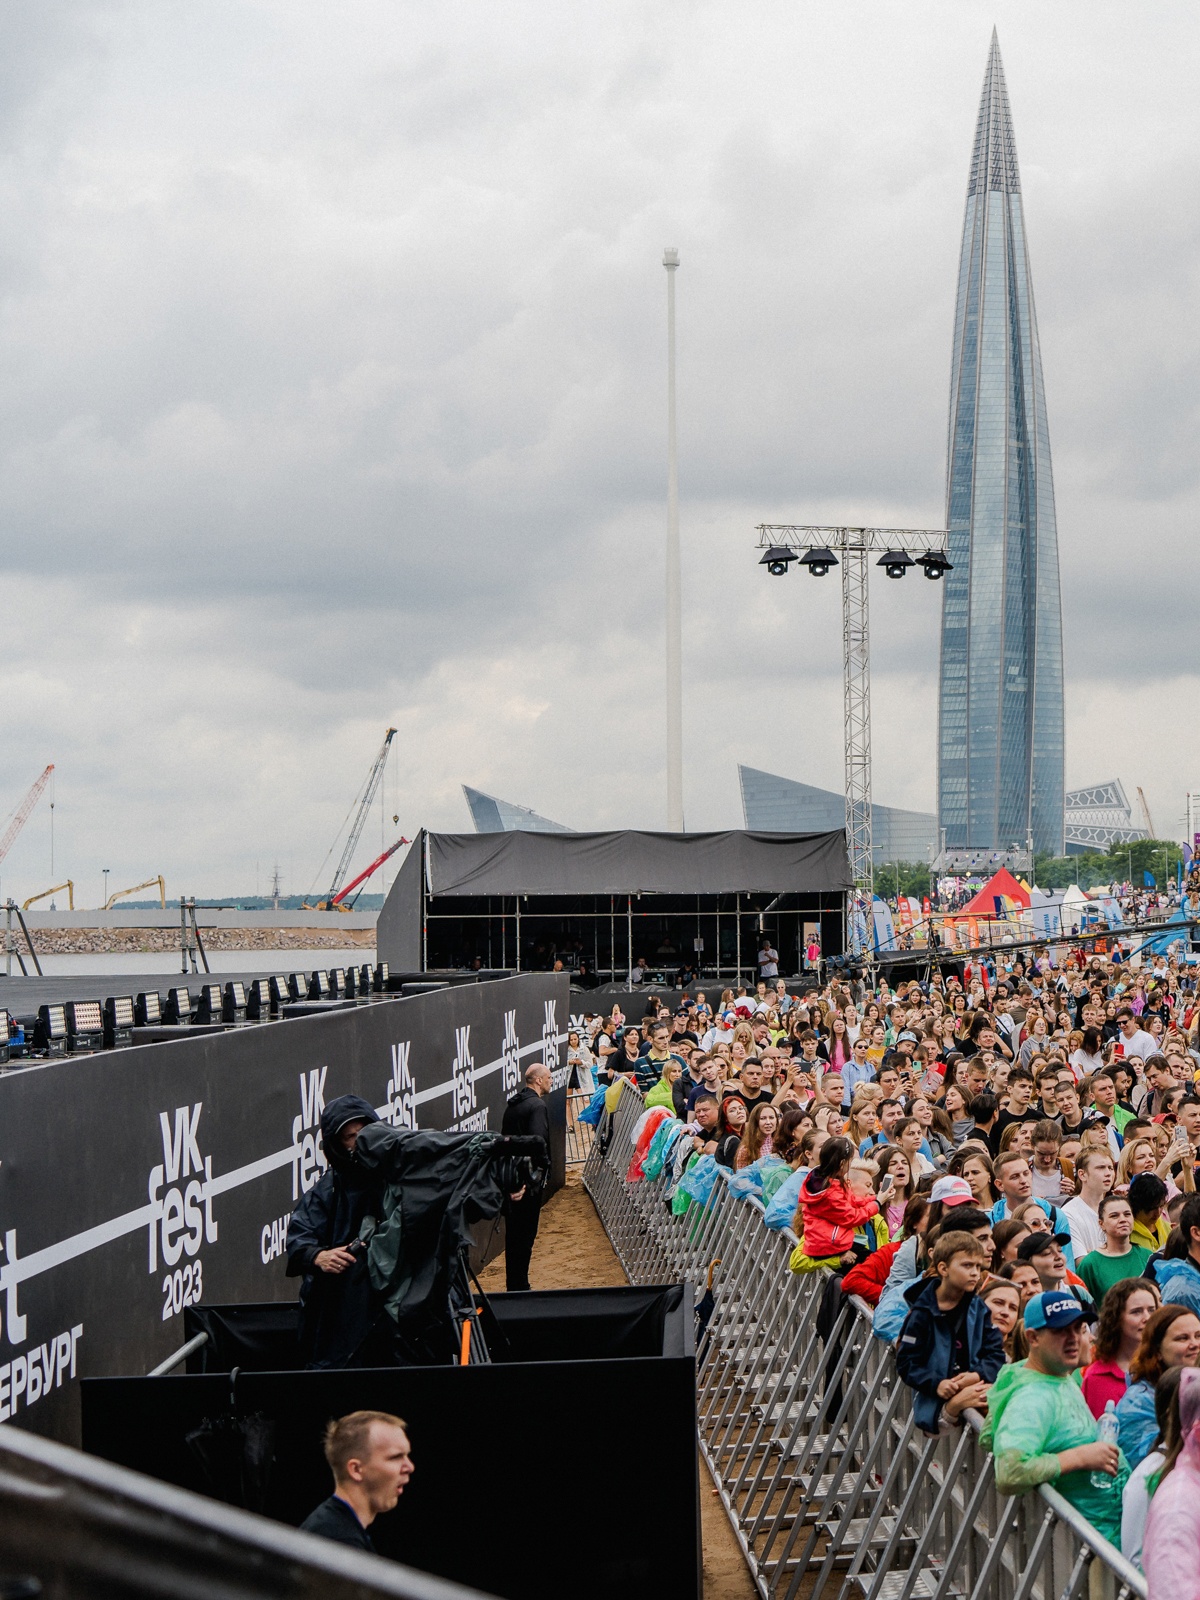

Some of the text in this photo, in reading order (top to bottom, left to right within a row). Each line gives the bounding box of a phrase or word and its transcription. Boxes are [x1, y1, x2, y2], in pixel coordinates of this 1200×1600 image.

[504, 1009, 517, 1049] VK
[545, 1000, 556, 1032] VK
[392, 1041, 411, 1092] VK
[456, 1025, 471, 1069] VK
[502, 1037, 521, 1091] fest
[300, 1066, 328, 1128] VK
[387, 1077, 418, 1130] fest
[453, 1056, 477, 1118] fest
[159, 1102, 204, 1184] VK
[292, 1114, 332, 1201] fes
[149, 1155, 218, 1274] fest
[162, 1259, 202, 1322] 2023
[1045, 1302, 1061, 1317] FC
